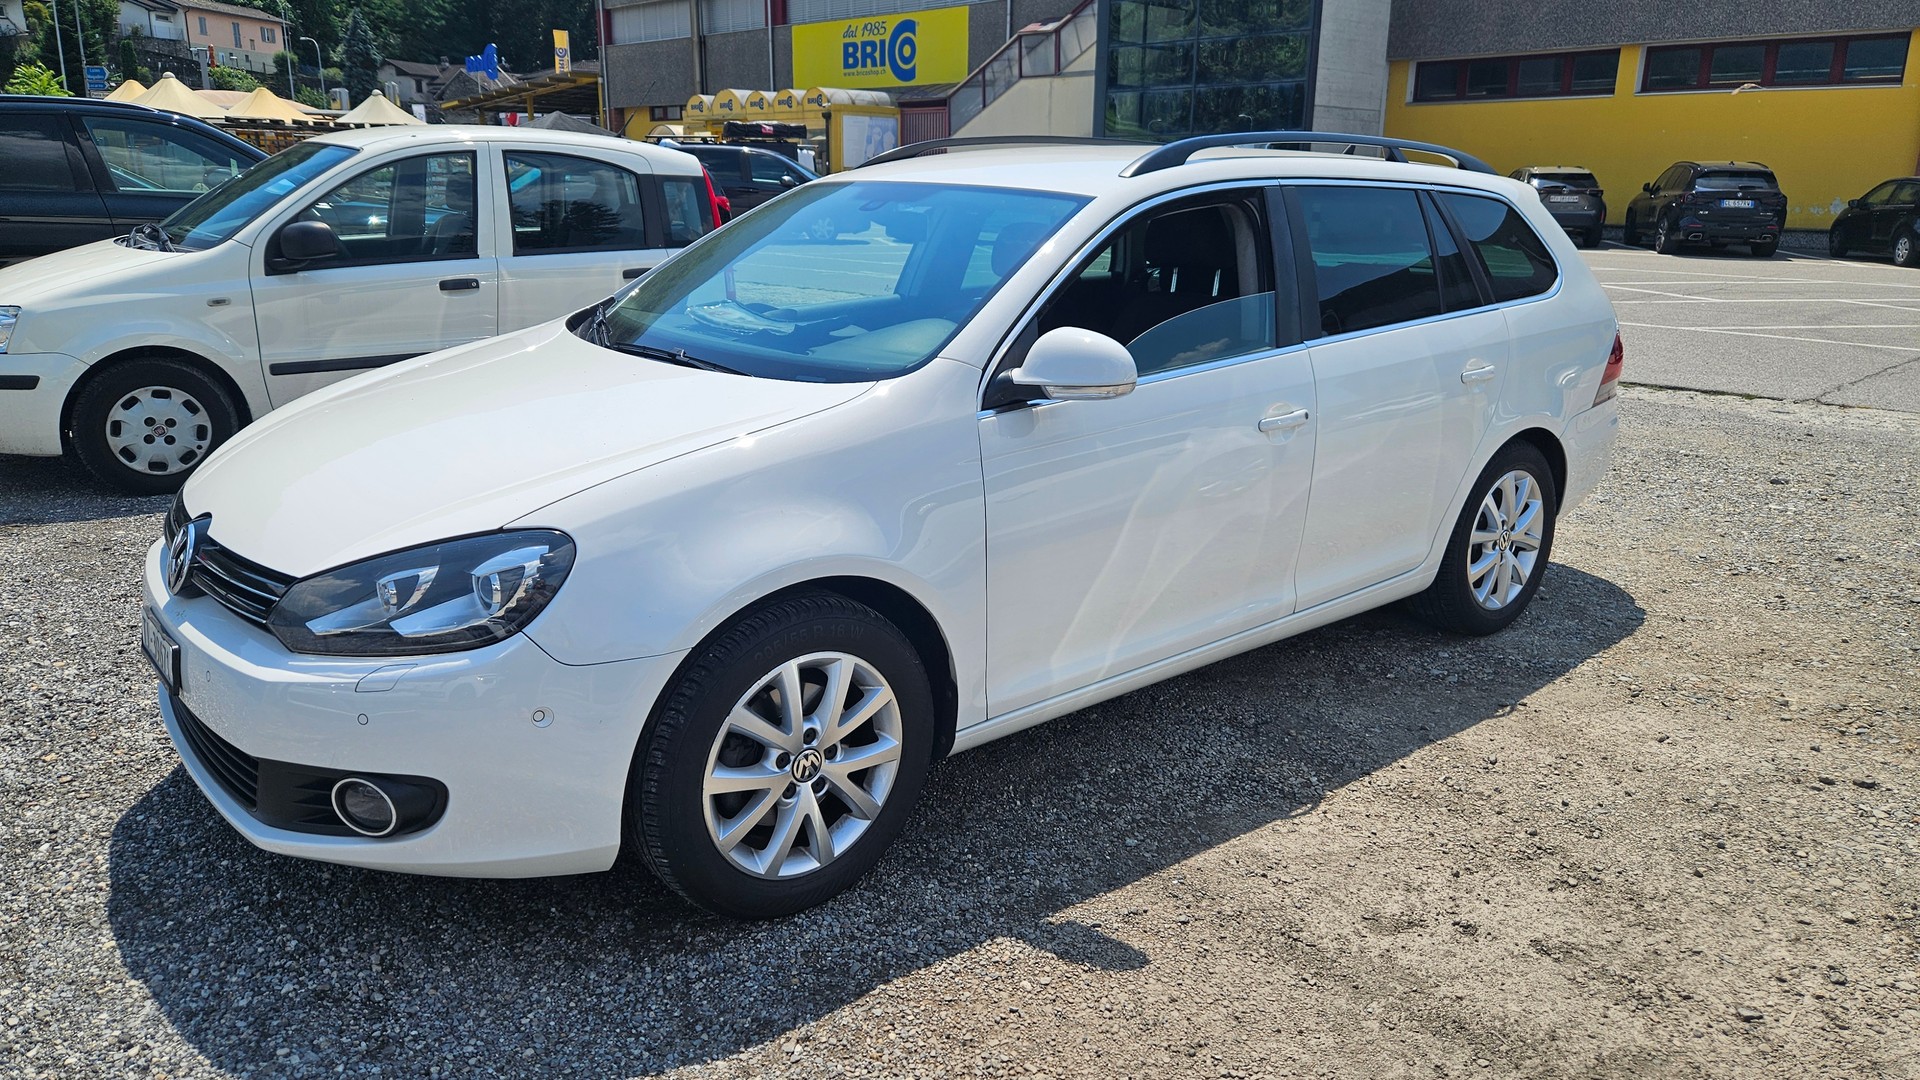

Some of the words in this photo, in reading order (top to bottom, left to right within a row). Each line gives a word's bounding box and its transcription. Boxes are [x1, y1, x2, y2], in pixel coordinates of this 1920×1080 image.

[843, 25, 858, 38] dal
[861, 21, 887, 37] 1985
[843, 19, 916, 82] BRICO
